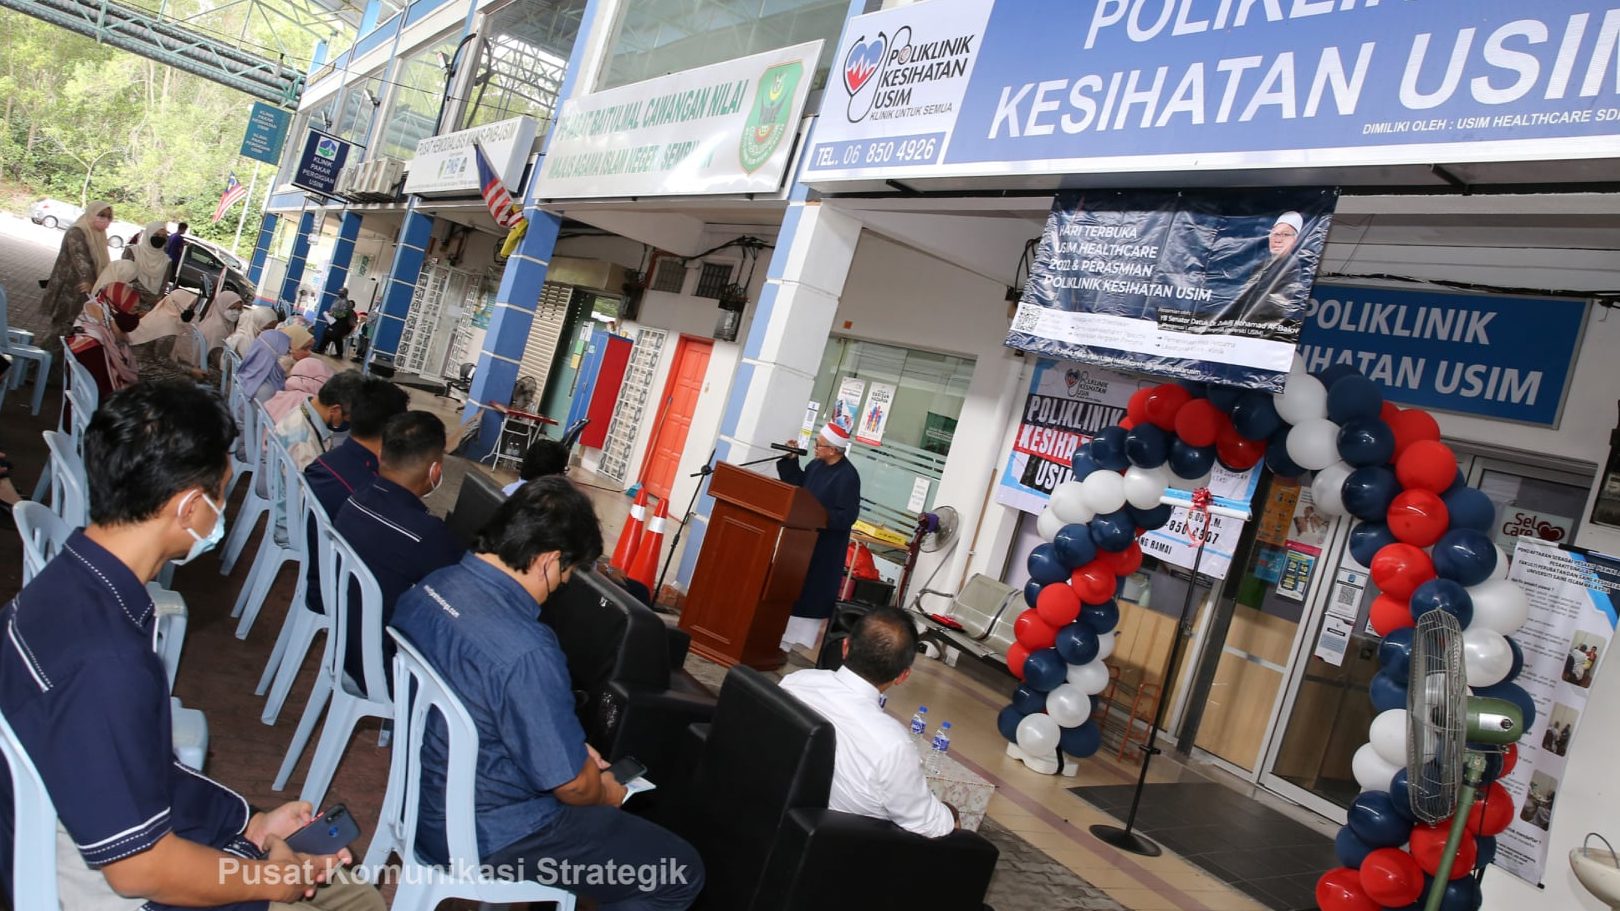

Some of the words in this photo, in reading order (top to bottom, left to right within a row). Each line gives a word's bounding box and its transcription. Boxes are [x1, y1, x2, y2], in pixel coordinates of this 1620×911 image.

[887, 34, 975, 66] POLIKLINIK
[881, 58, 968, 88] KESIHATAN
[874, 87, 912, 109] USIM
[988, 41, 1376, 139] KESIHATAN
[590, 100, 644, 136] BAITULMAL
[642, 87, 712, 128] CAWANGAN
[707, 79, 749, 117] NILAI
[869, 109, 893, 121] KLINIK
[895, 106, 921, 119] UNTUK
[922, 102, 952, 116] SEMUA
[1362, 121, 1410, 135] DIMILIKI
[1412, 119, 1446, 132] OLEH
[1457, 117, 1490, 130] USIM
[1493, 109, 1592, 128] HEALTHCARE
[313, 156, 333, 168] KLINIK
[601, 147, 629, 175] ISLAM
[816, 147, 838, 167] TEL.
[843, 144, 861, 164] 06
[866, 141, 895, 163] 850
[896, 138, 936, 161] 4926
[302, 169, 335, 184] PERGIGIAN
[310, 164, 331, 175] PAKAR
[1085, 226, 1137, 239] TERBUKA
[1079, 243, 1159, 259] HEALTHCARE
[1071, 259, 1079, 271] &
[1081, 260, 1155, 277] PERASMIAN
[1102, 279, 1174, 298] KESIHATAN
[1176, 287, 1213, 302] USIM
[1306, 299, 1497, 345] POLIKLINIK
[1434, 360, 1543, 406] USIM
[1026, 395, 1124, 433] POLIKLINIK
[1502, 522, 1533, 536] Care
[1150, 540, 1172, 555] RAMAI
